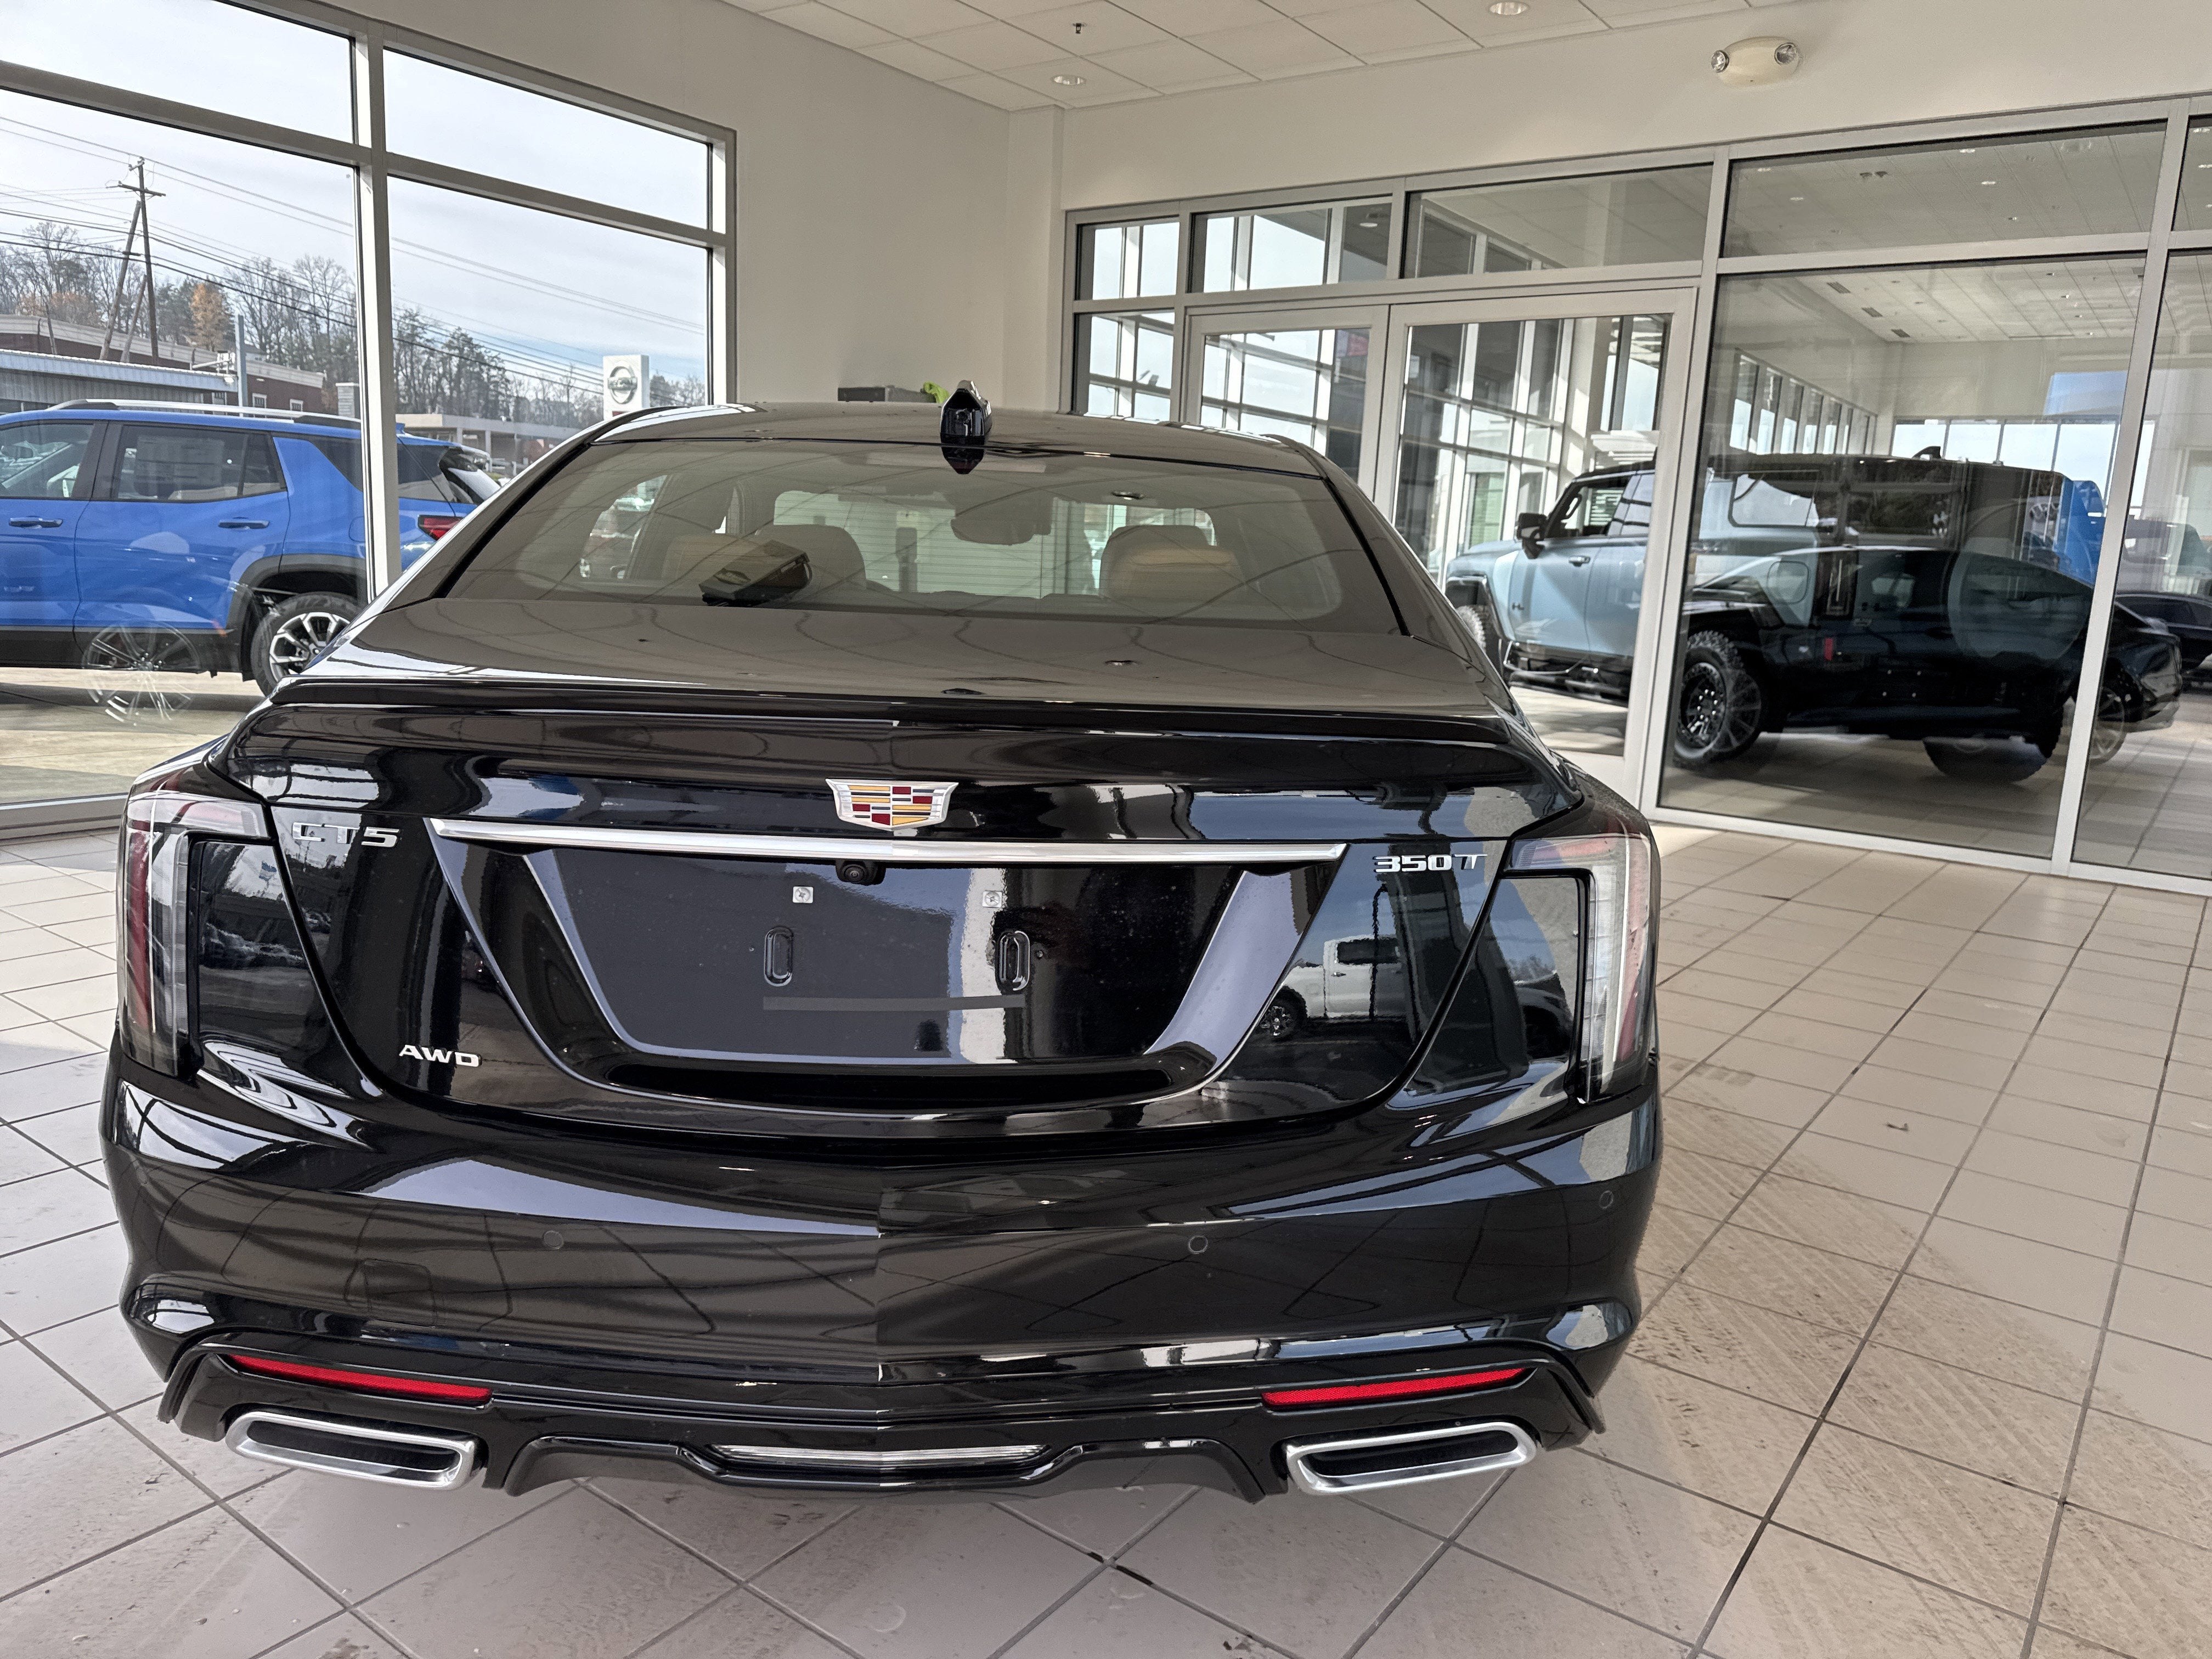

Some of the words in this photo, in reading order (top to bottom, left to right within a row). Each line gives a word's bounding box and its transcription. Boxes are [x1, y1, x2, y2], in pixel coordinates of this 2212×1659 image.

[291, 822, 400, 848] CT5
[1373, 854, 1488, 872] 350T
[398, 1044, 481, 1067] AWD
